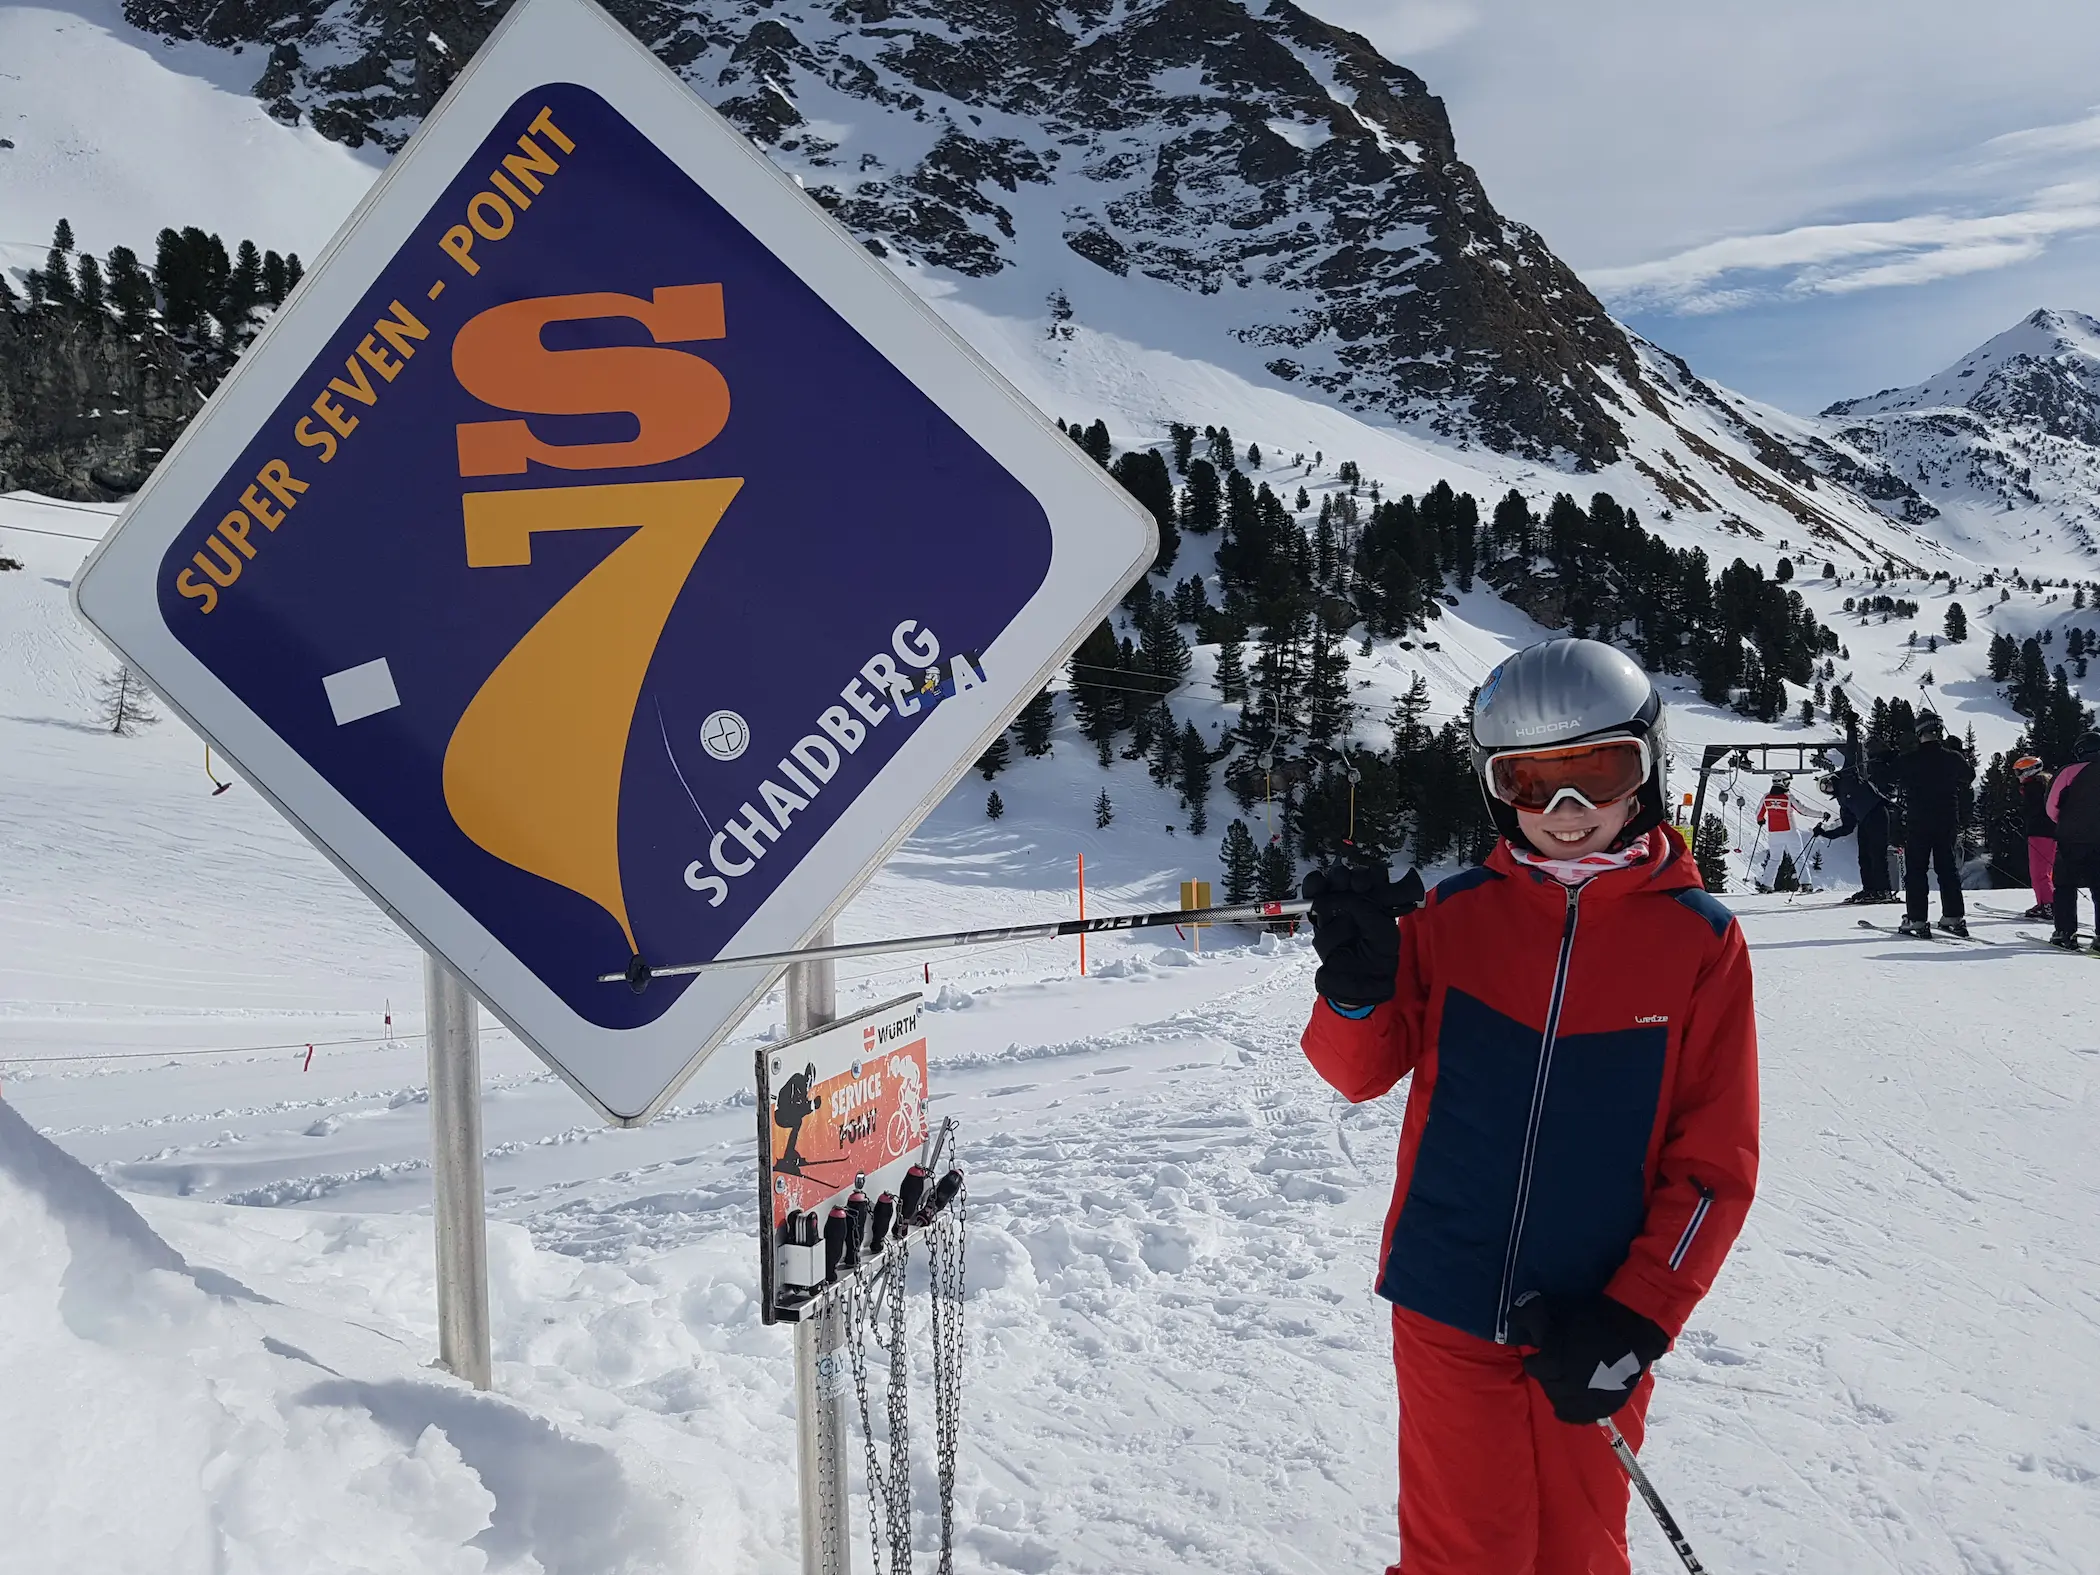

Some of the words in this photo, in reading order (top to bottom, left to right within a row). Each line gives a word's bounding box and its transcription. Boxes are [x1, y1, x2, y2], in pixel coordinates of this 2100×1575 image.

[176, 458, 310, 614] SUPER
[294, 299, 431, 464] SEVEN
[438, 106, 576, 277] POINT
[452, 282, 732, 477] S
[442, 477, 745, 955] 7
[683, 619, 940, 908] SCHAIDBERG
[1515, 719, 1581, 737] HUDORA
[831, 1072, 882, 1119] SERVICE
[877, 1014, 916, 1044] WÜRTH
